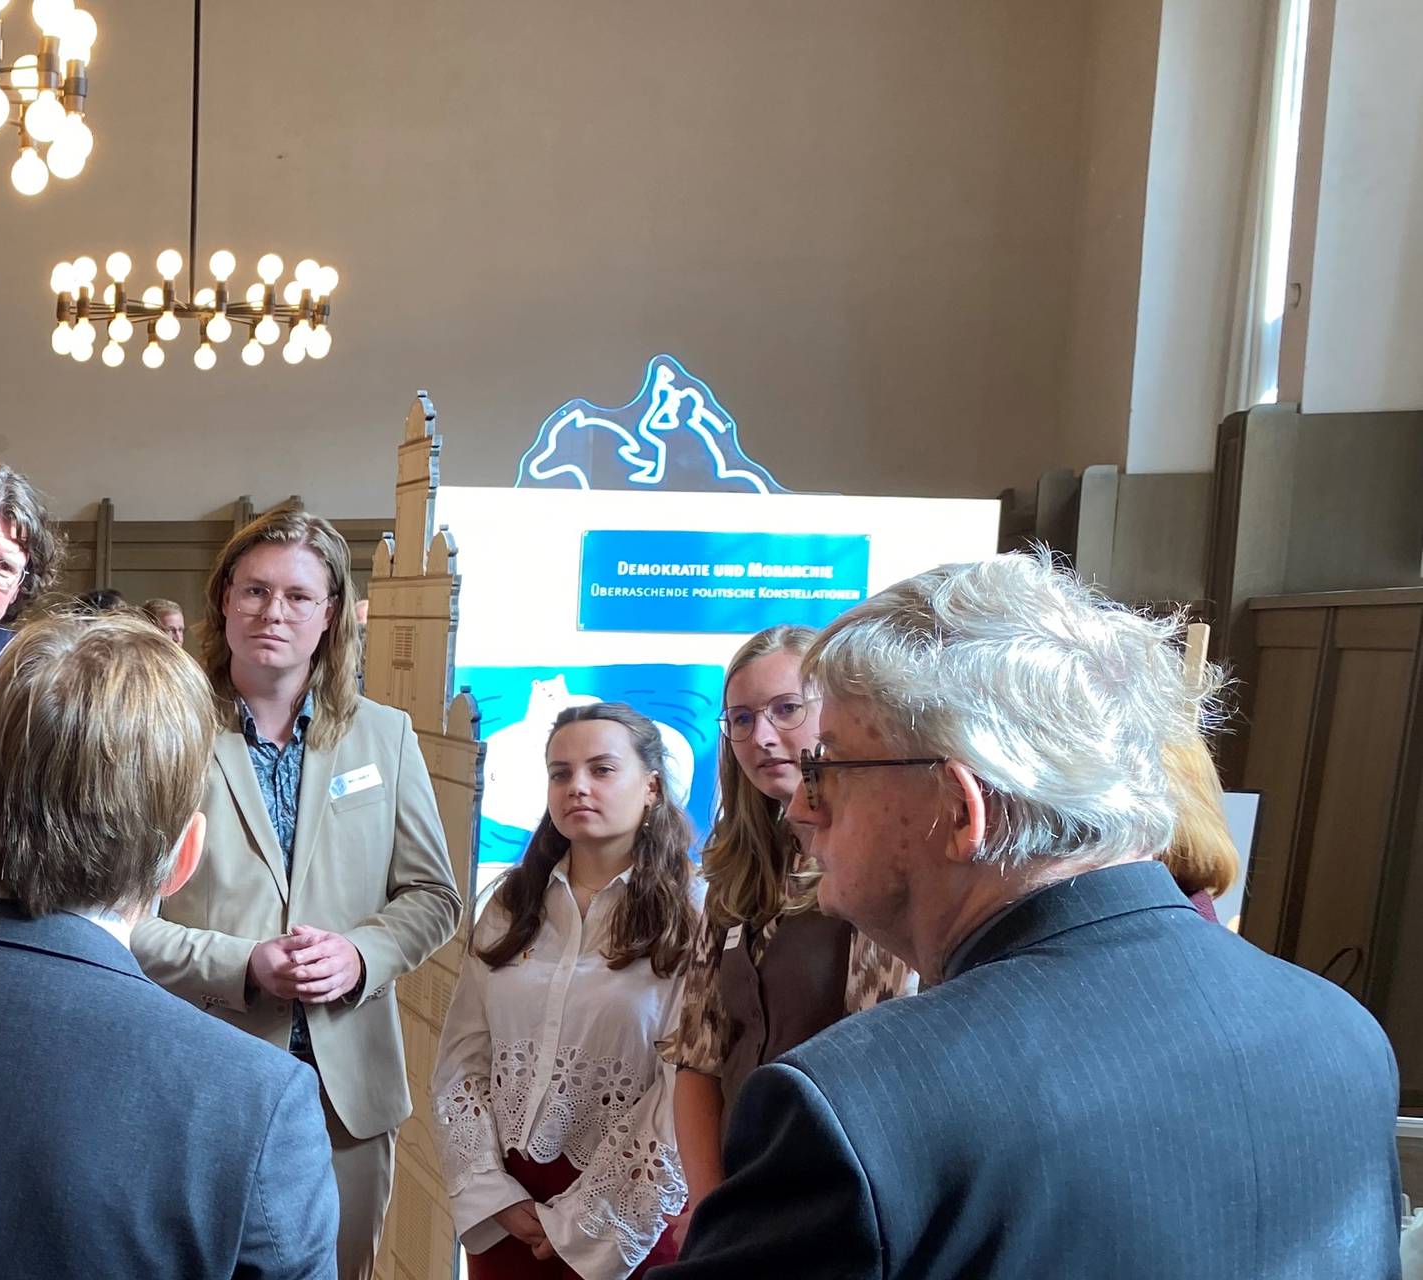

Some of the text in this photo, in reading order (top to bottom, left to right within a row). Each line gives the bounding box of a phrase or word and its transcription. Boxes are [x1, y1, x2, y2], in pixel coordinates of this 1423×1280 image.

[617, 561, 710, 577] DEMOKRATIE
[713, 564, 745, 578] UND
[590, 583, 689, 598] ÜBERRASCHENDE
[692, 588, 756, 599] POLITISCHE
